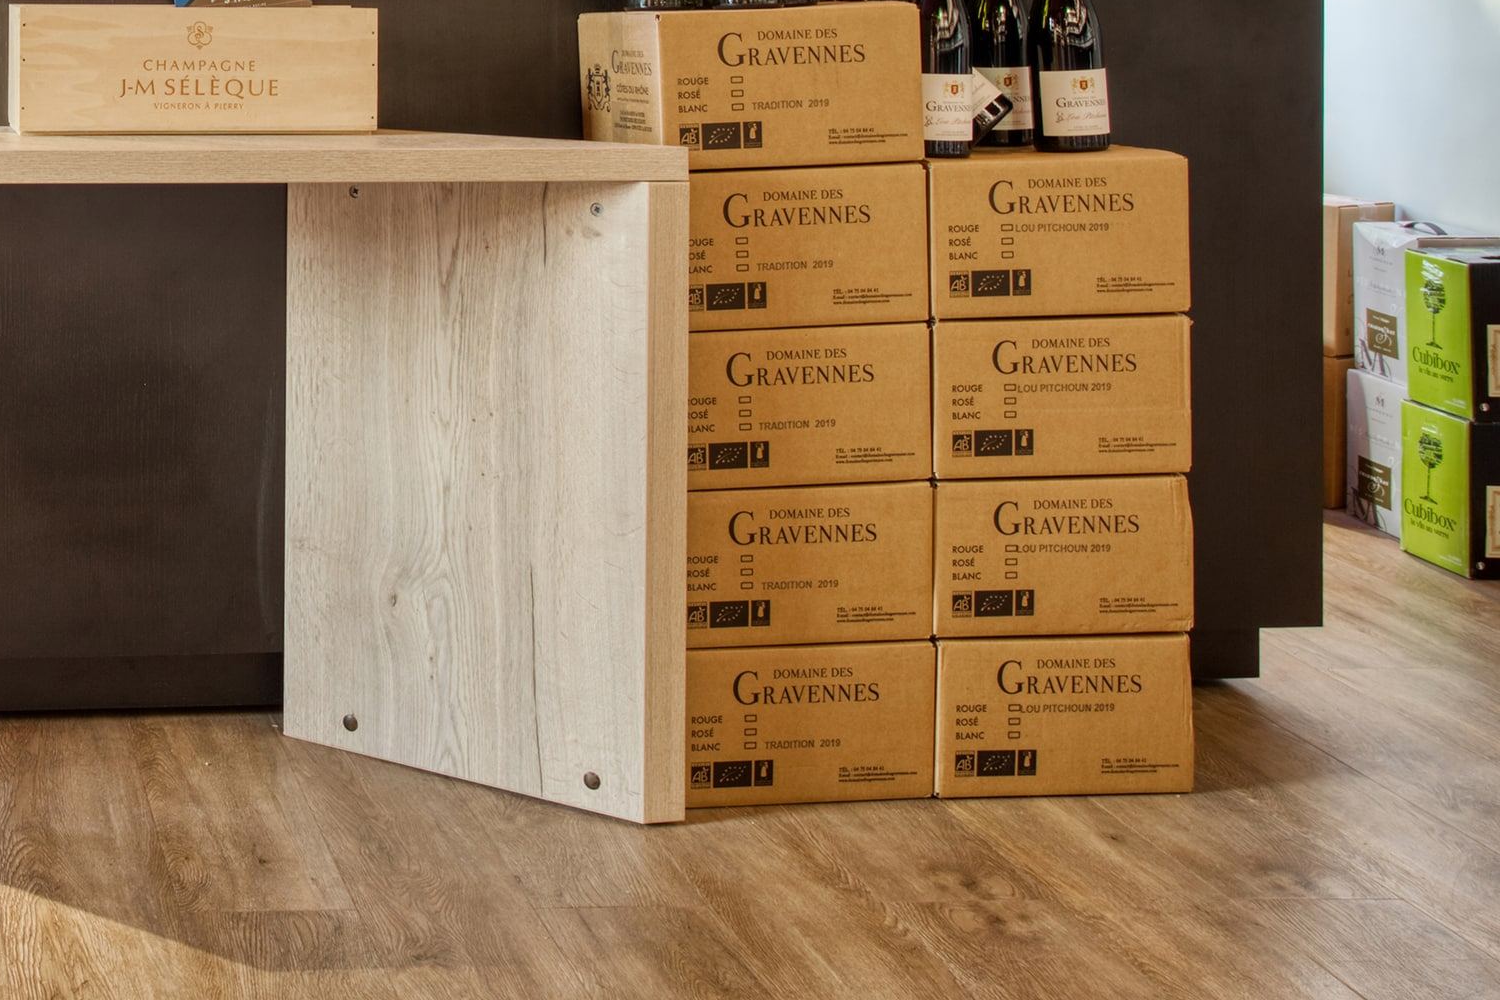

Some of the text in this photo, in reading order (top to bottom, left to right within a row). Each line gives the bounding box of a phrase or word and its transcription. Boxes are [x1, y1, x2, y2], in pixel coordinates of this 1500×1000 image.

[757, 29, 838, 41] DOMAINE DES
[718, 32, 866, 67] GRAVENNES
[143, 60, 256, 72] CHAMPAGNE
[120, 75, 279, 99] J-M SÉLÈQUE
[677, 77, 709, 86] ROUGE
[678, 89, 701, 99] ROSÉ
[205, 101, 211, 110] À
[678, 104, 708, 113] BLANC
[752, 99, 829, 111] TRADITION 2019
[1028, 177, 1107, 188] DOMAINE DES
[763, 189, 843, 201] DOMAINE DES
[988, 180, 1134, 215] GRAVENNES
[723, 193, 871, 228] GRAVENNES
[949, 223, 1109, 233] ROUGE LOU PITCHOUN 2019
[949, 237, 971, 247] ROSÉ
[949, 251, 978, 260] BLANC
[757, 260, 834, 271] TRADITION 2019
[1032, 337, 1110, 349] DOMAINE DES
[767, 349, 847, 360] DOMAINE DES
[992, 340, 1137, 374] GRAVENNES
[1413, 346, 1459, 375] Cubibox
[726, 352, 875, 387] GRAVENNES
[952, 383, 1111, 393] ROUGE LOU PITCHOUN 2019
[952, 396, 974, 406] ROSÉ
[952, 411, 981, 420] BLANC
[759, 419, 836, 431] TRADITION 2019
[1033, 499, 1113, 510] DOMAINE DES
[770, 508, 850, 520] DOMAINE DES
[994, 501, 1139, 536] GRAVENNES
[1405, 498, 1454, 531] Cubibox
[729, 511, 877, 545] GRAVENNES
[952, 544, 1111, 554] ROUGE LOU PITCHOUN 2019
[687, 556, 719, 564] ROUGE
[952, 557, 975, 567] ROSÉ
[687, 568, 710, 577] ROSÉ
[952, 572, 981, 581] BLANC
[687, 583, 716, 591] BLANC
[762, 580, 839, 591] TRADITION 2019
[1037, 658, 1116, 669] DOMAINE DES
[773, 667, 853, 679] DOMAINE DES
[997, 660, 1142, 695] GRAVENNES
[733, 671, 880, 705] GRAVENNES
[956, 703, 1115, 713] ROUGE LOU PITCHOUN 2019
[692, 716, 723, 724] ROUGE
[956, 716, 979, 726] ROSÉ
[692, 728, 714, 737] ROSÉ
[956, 731, 984, 740] BLANC
[692, 743, 720, 751] BLANC
[765, 739, 840, 750] TRADITION 2019
